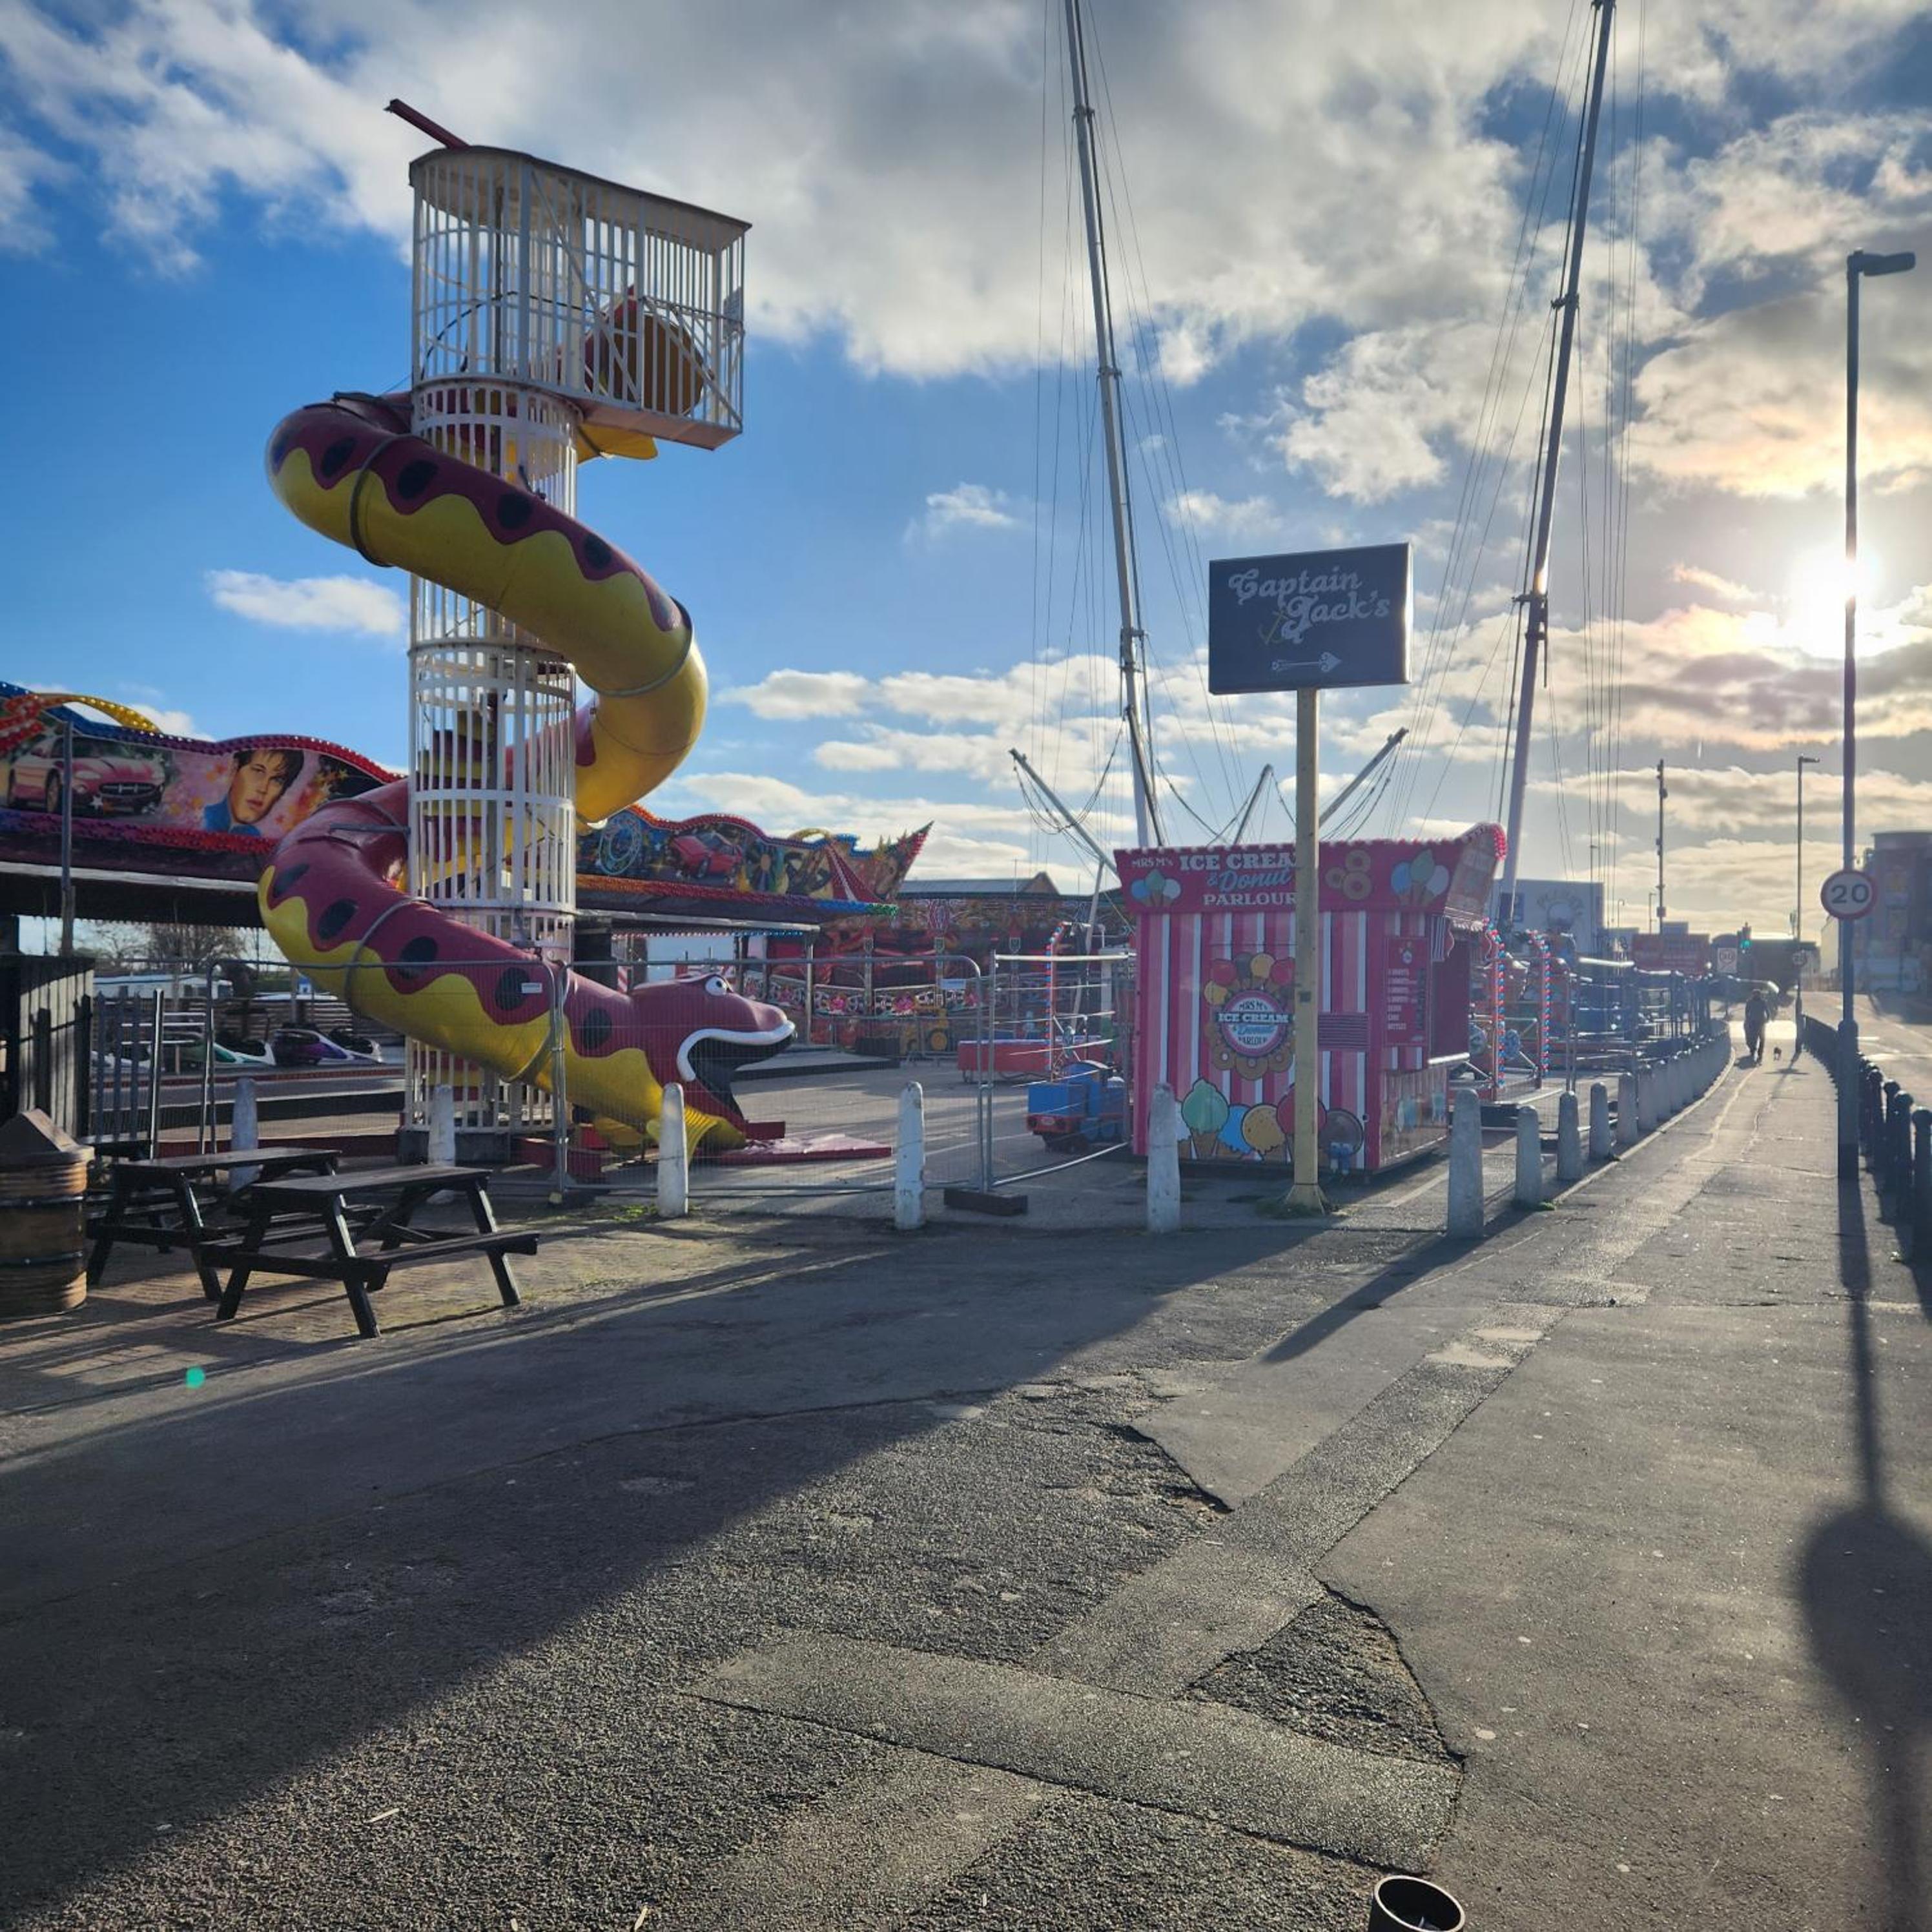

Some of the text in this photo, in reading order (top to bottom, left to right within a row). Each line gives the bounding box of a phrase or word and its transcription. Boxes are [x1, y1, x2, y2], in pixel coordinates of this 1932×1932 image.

[1228, 566, 1362, 611] Captain
[1281, 590, 1390, 644] Jack's
[1179, 851, 1296, 871] ICE CREA
[1831, 884, 1869, 903] 20
[1218, 1012, 1289, 1023] ICE CREAM
